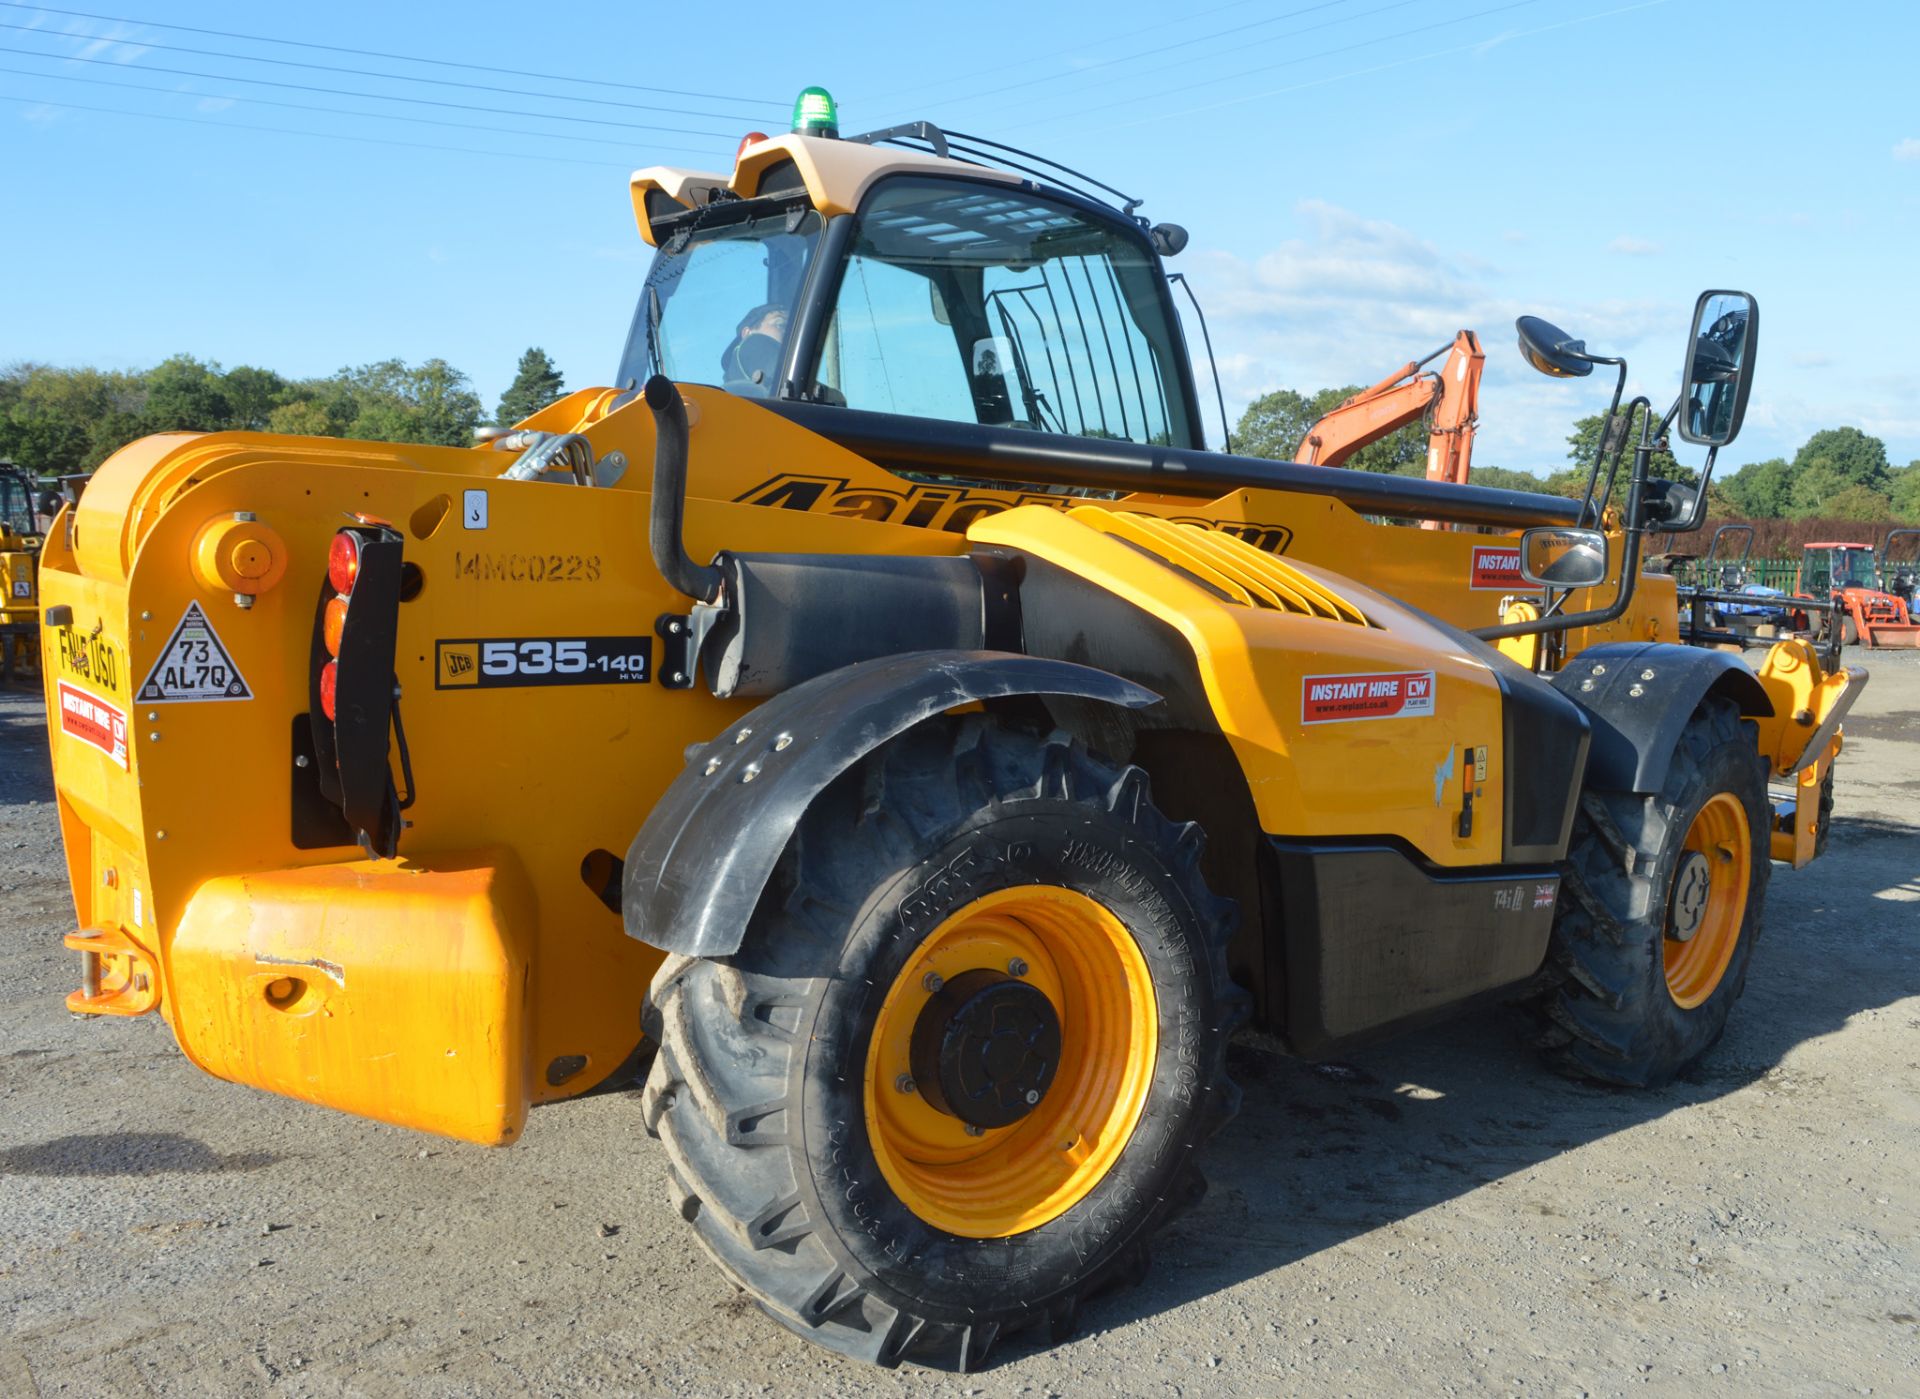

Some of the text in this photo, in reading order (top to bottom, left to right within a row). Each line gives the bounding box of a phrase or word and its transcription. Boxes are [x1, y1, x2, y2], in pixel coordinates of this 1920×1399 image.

[1478, 555, 1520, 570] INSTANT
[179, 640, 209, 664] 73
[449, 655, 473, 675] JCB
[163, 666, 226, 689] AL7Q
[1311, 681, 1399, 701] INSTANT HIRE
[1407, 680, 1427, 697] CW
